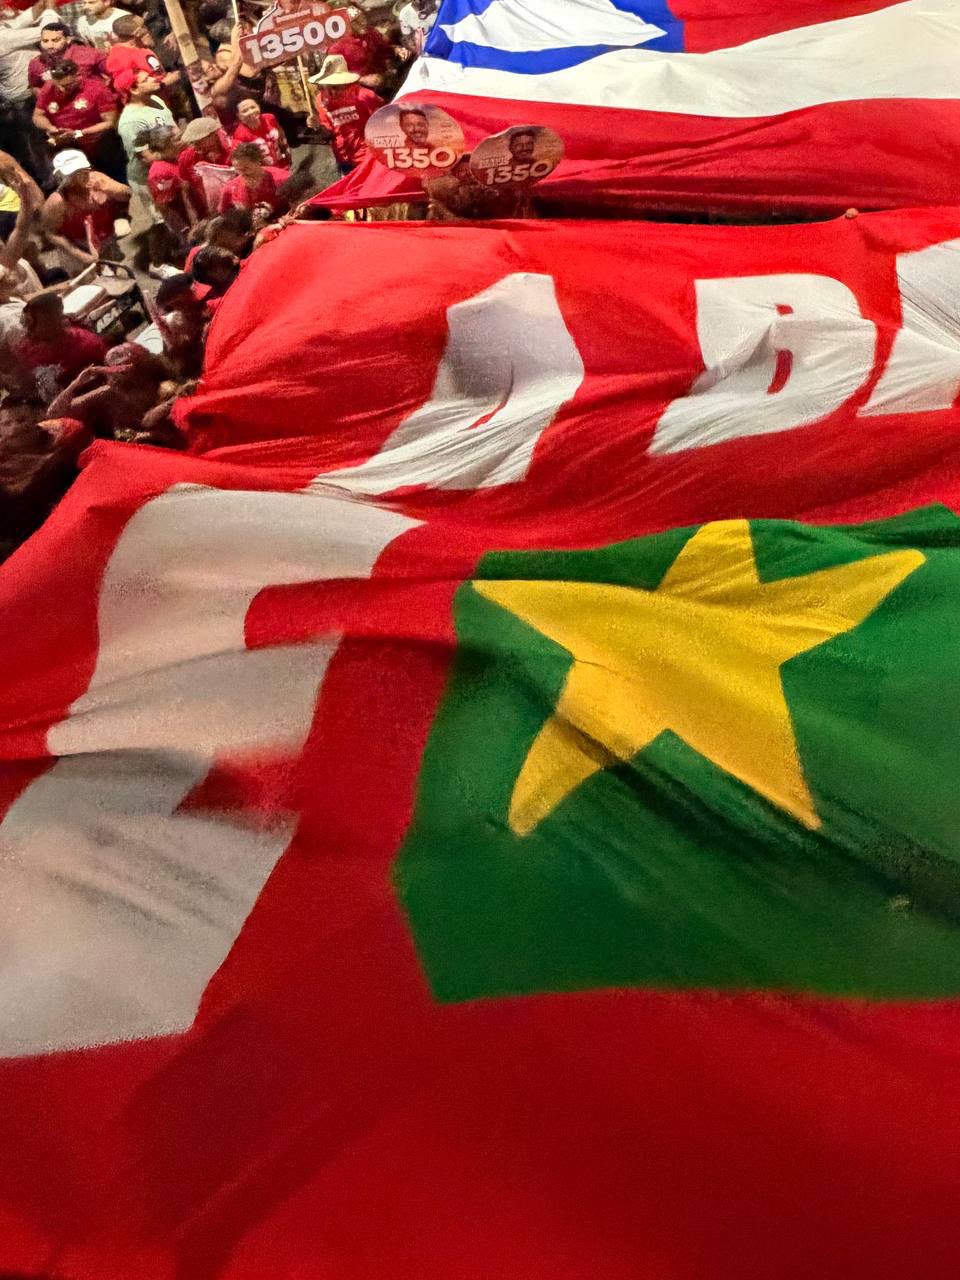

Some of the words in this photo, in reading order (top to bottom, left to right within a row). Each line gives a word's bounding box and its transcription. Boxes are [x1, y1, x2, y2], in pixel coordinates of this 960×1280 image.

[245, 15, 346, 64] 13500
[383, 146, 456, 169] 1350
[486, 159, 552, 186] 1350
